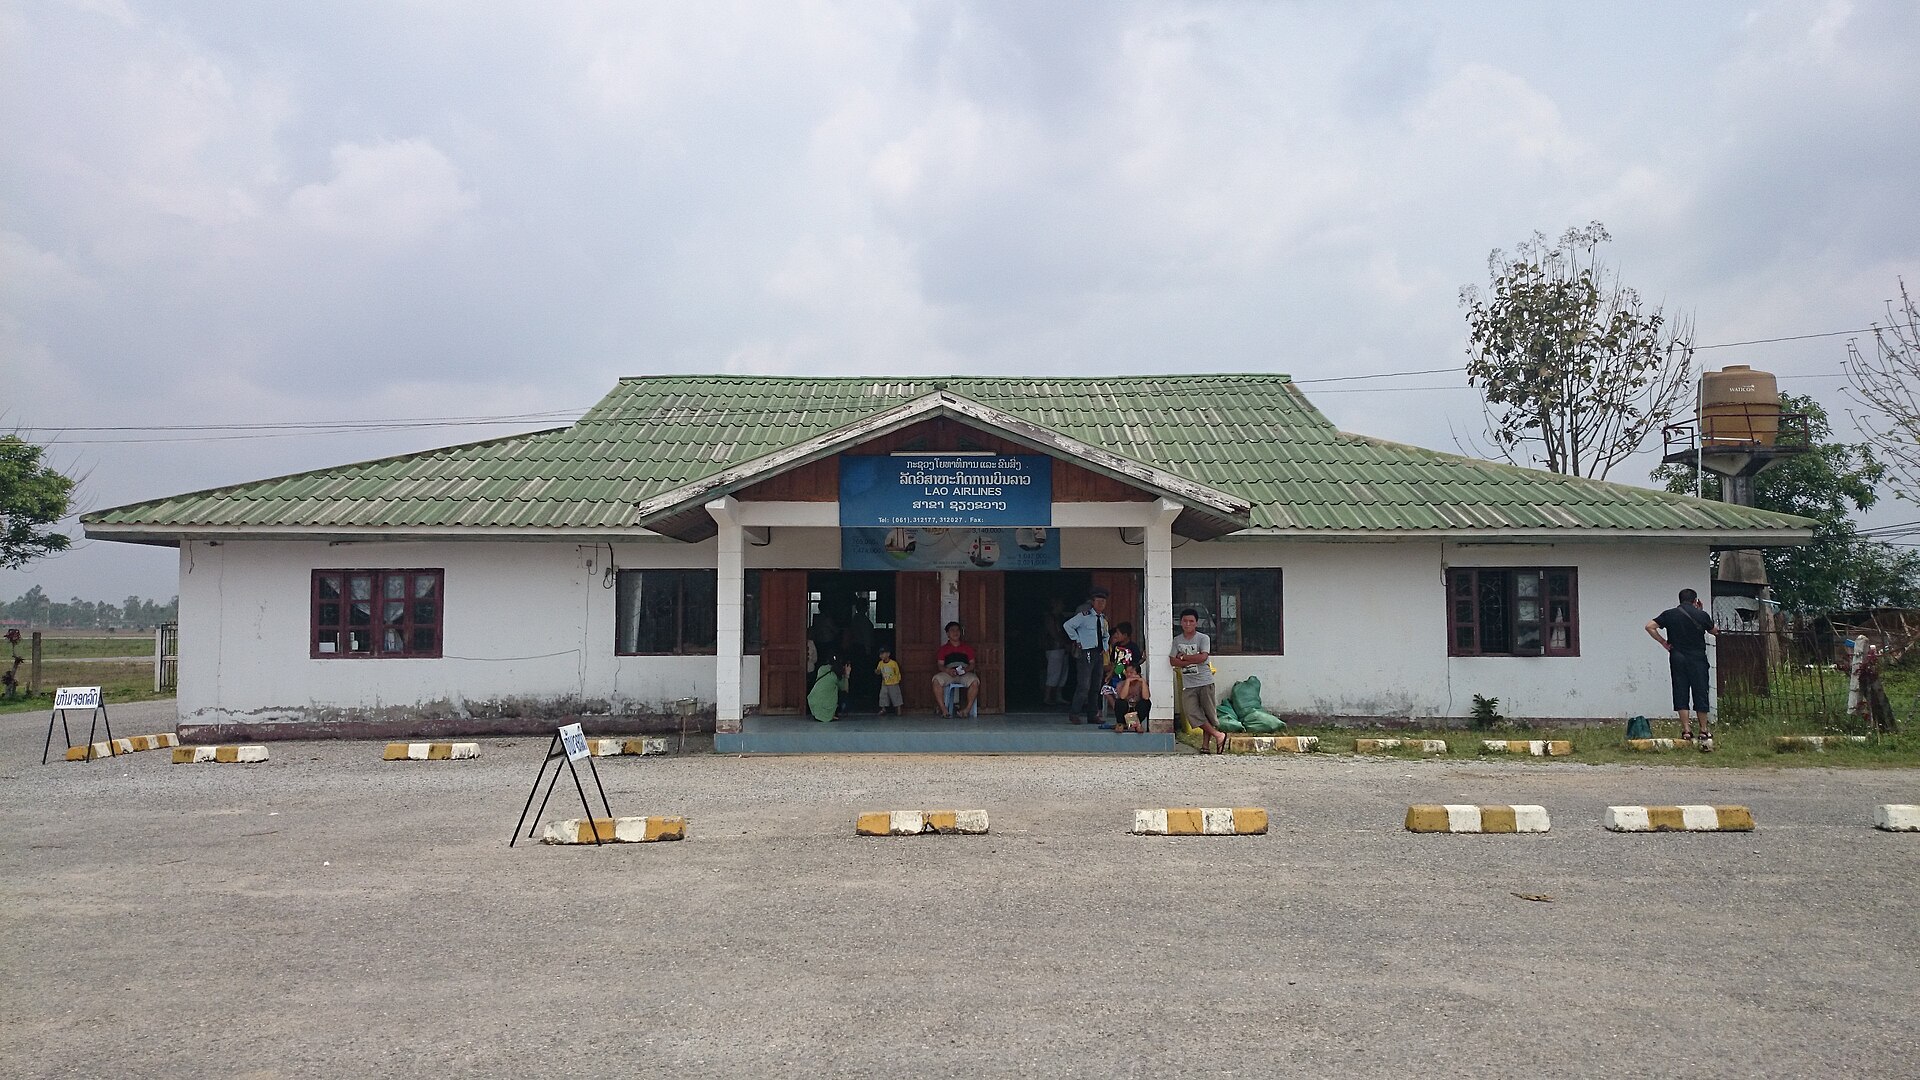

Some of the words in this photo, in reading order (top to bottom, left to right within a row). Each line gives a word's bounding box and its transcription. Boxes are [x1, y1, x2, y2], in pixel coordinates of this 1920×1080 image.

[925, 487, 948, 496] LAO
[953, 487, 1002, 496] AIRLINES
[912, 500, 944, 509] ສາຂາ
